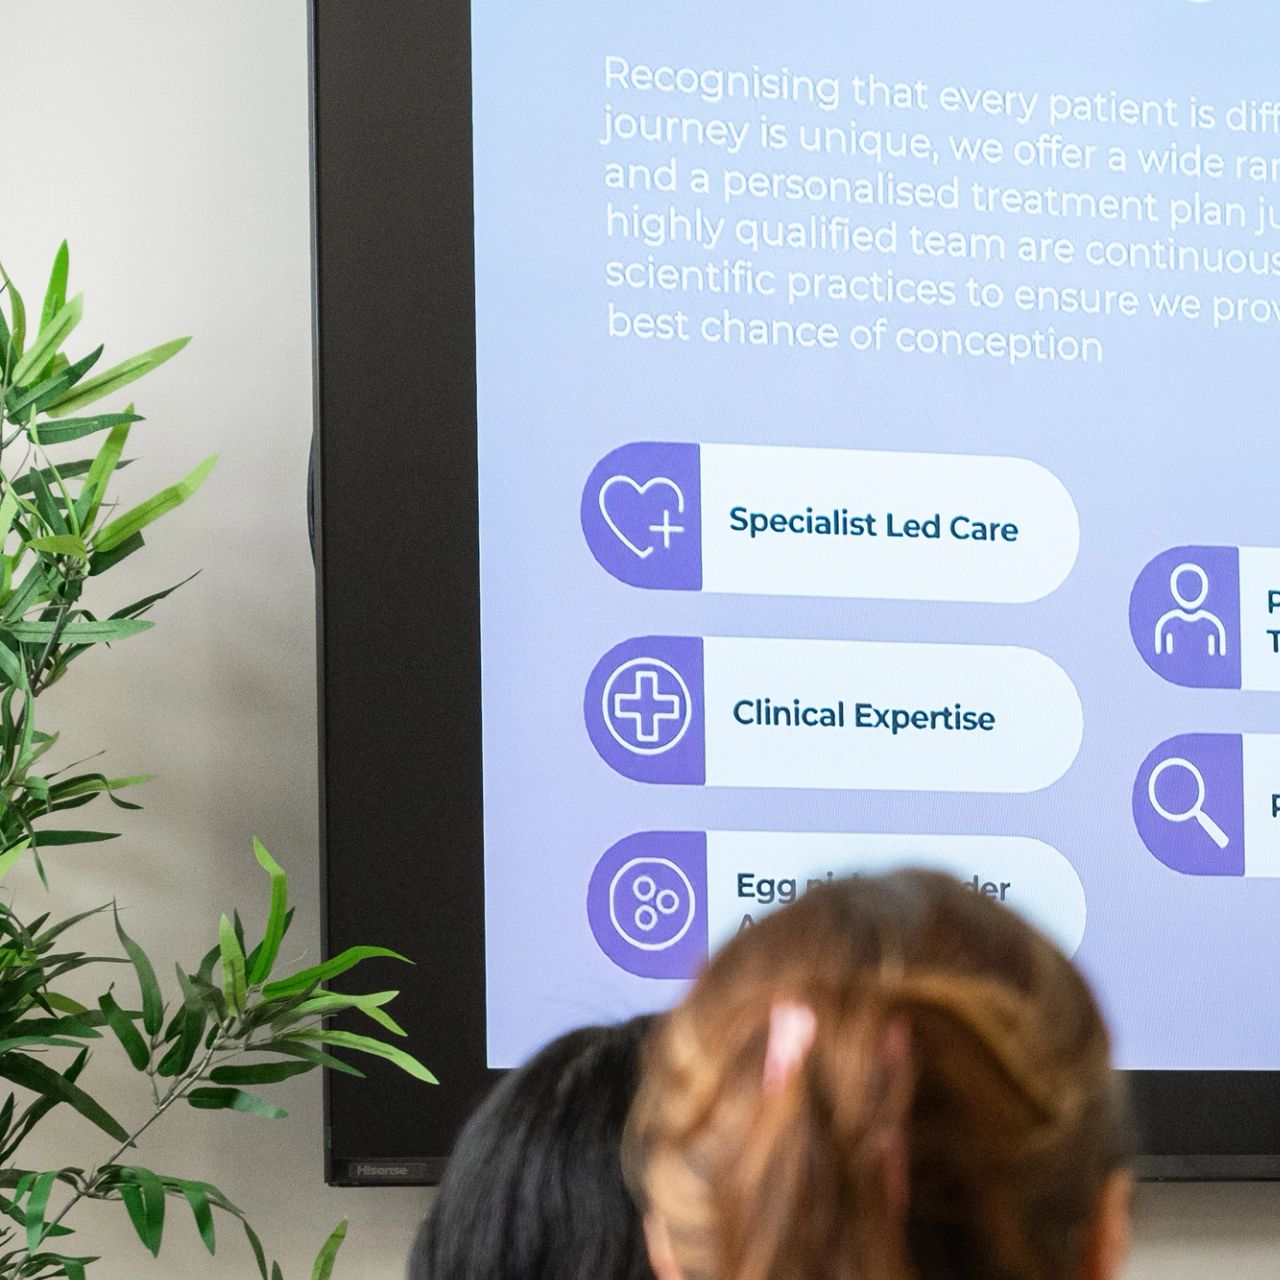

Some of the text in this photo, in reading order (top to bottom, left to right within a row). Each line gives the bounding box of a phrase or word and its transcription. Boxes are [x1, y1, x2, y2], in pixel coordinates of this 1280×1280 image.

[604, 55, 840, 112] Recognising
[851, 73, 929, 110] that
[939, 86, 1039, 126] every
[1049, 90, 1179, 128] patient
[1189, 96, 1217, 130] is
[598, 103, 751, 154] journey
[760, 114, 789, 150] is
[799, 120, 940, 166] unique,
[948, 135, 1004, 164] we
[1013, 133, 1097, 170] offer
[1108, 146, 1127, 172] a
[1136, 142, 1225, 178] wide
[605, 157, 679, 192] and
[689, 168, 710, 194] a
[723, 170, 960, 210] personalised
[970, 181, 1159, 222] treatment
[1170, 191, 1246, 231] plan
[606, 202, 726, 251] highly
[735, 215, 898, 254] qualified
[909, 225, 1006, 260] team
[1017, 236, 1075, 264] are
[606, 254, 777, 296] scientific
[787, 268, 957, 306] practices
[965, 277, 1005, 309] to
[1014, 285, 1140, 316] ensure
[1147, 292, 1201, 319] we
[608, 302, 1103, 366] best chance of conception
[729, 505, 1019, 543] Specialist Led Care
[732, 697, 996, 736] Clinical Expertise
[736, 872, 797, 905] Egg
[356, 1164, 408, 1176] Hisense
